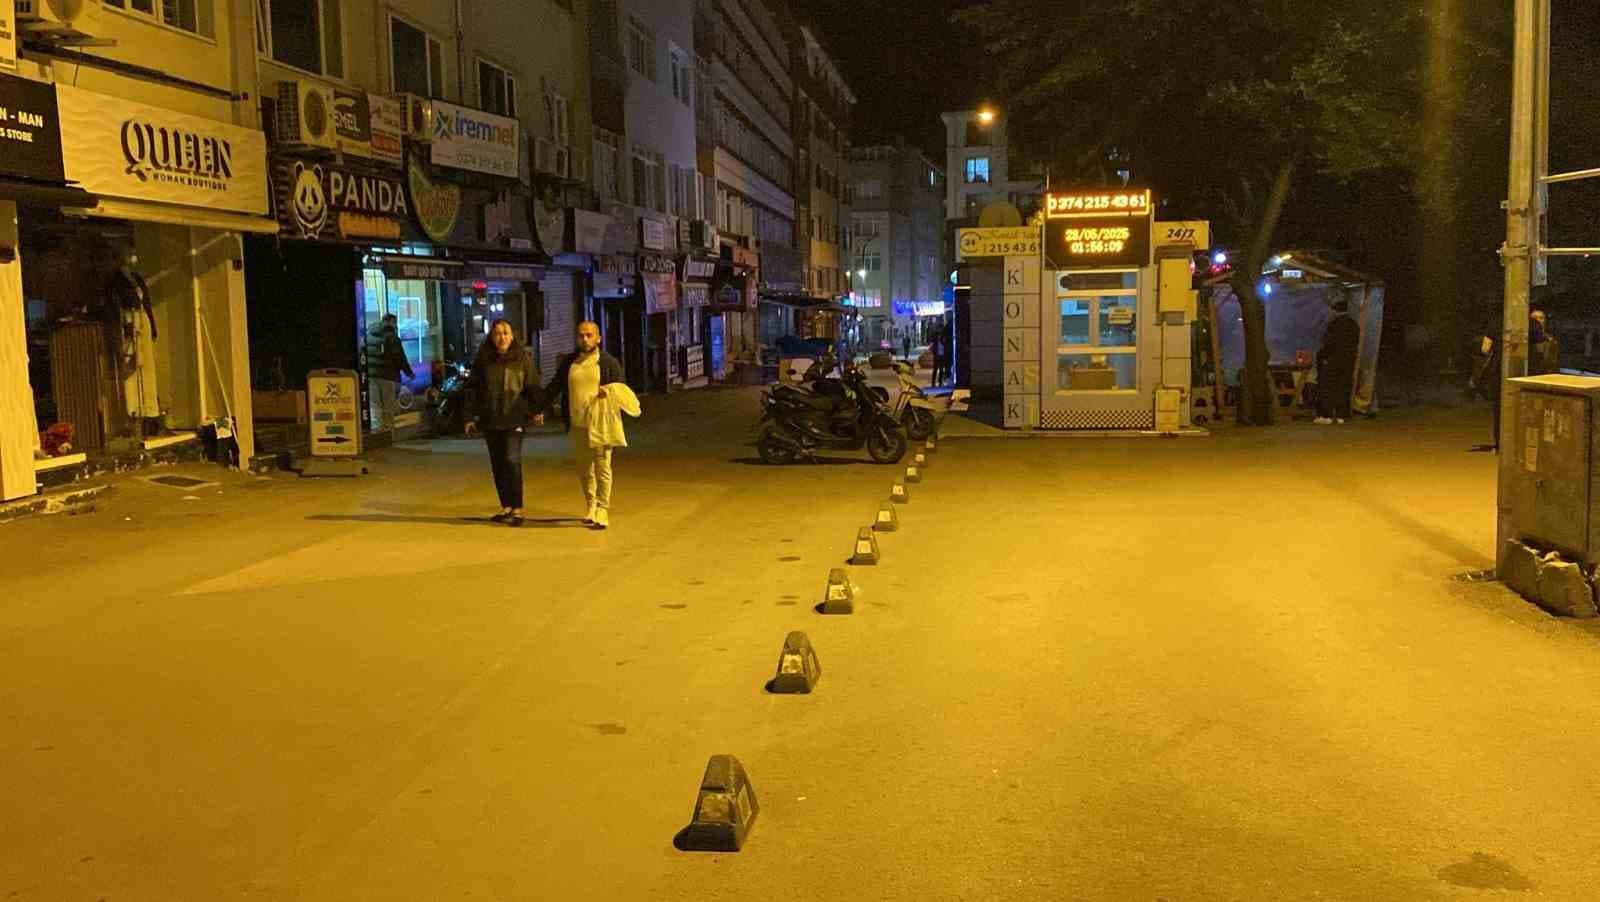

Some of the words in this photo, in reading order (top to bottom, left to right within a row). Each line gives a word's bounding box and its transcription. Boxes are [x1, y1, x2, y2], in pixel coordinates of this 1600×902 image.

[17, 111, 44, 128] MAN
[455, 110, 514, 146] iremnet
[6, 128, 33, 142] STORE
[120, 119, 233, 181] QUEEN
[152, 173, 187, 185] WOMAN
[187, 177, 228, 191] BOUTIQUE
[329, 171, 407, 214] PANDA
[1058, 197, 1083, 210] 374
[1085, 195, 1110, 209] 215
[1129, 194, 1146, 207] 61
[989, 242, 1010, 253] 215
[1013, 242, 1026, 252] 43
